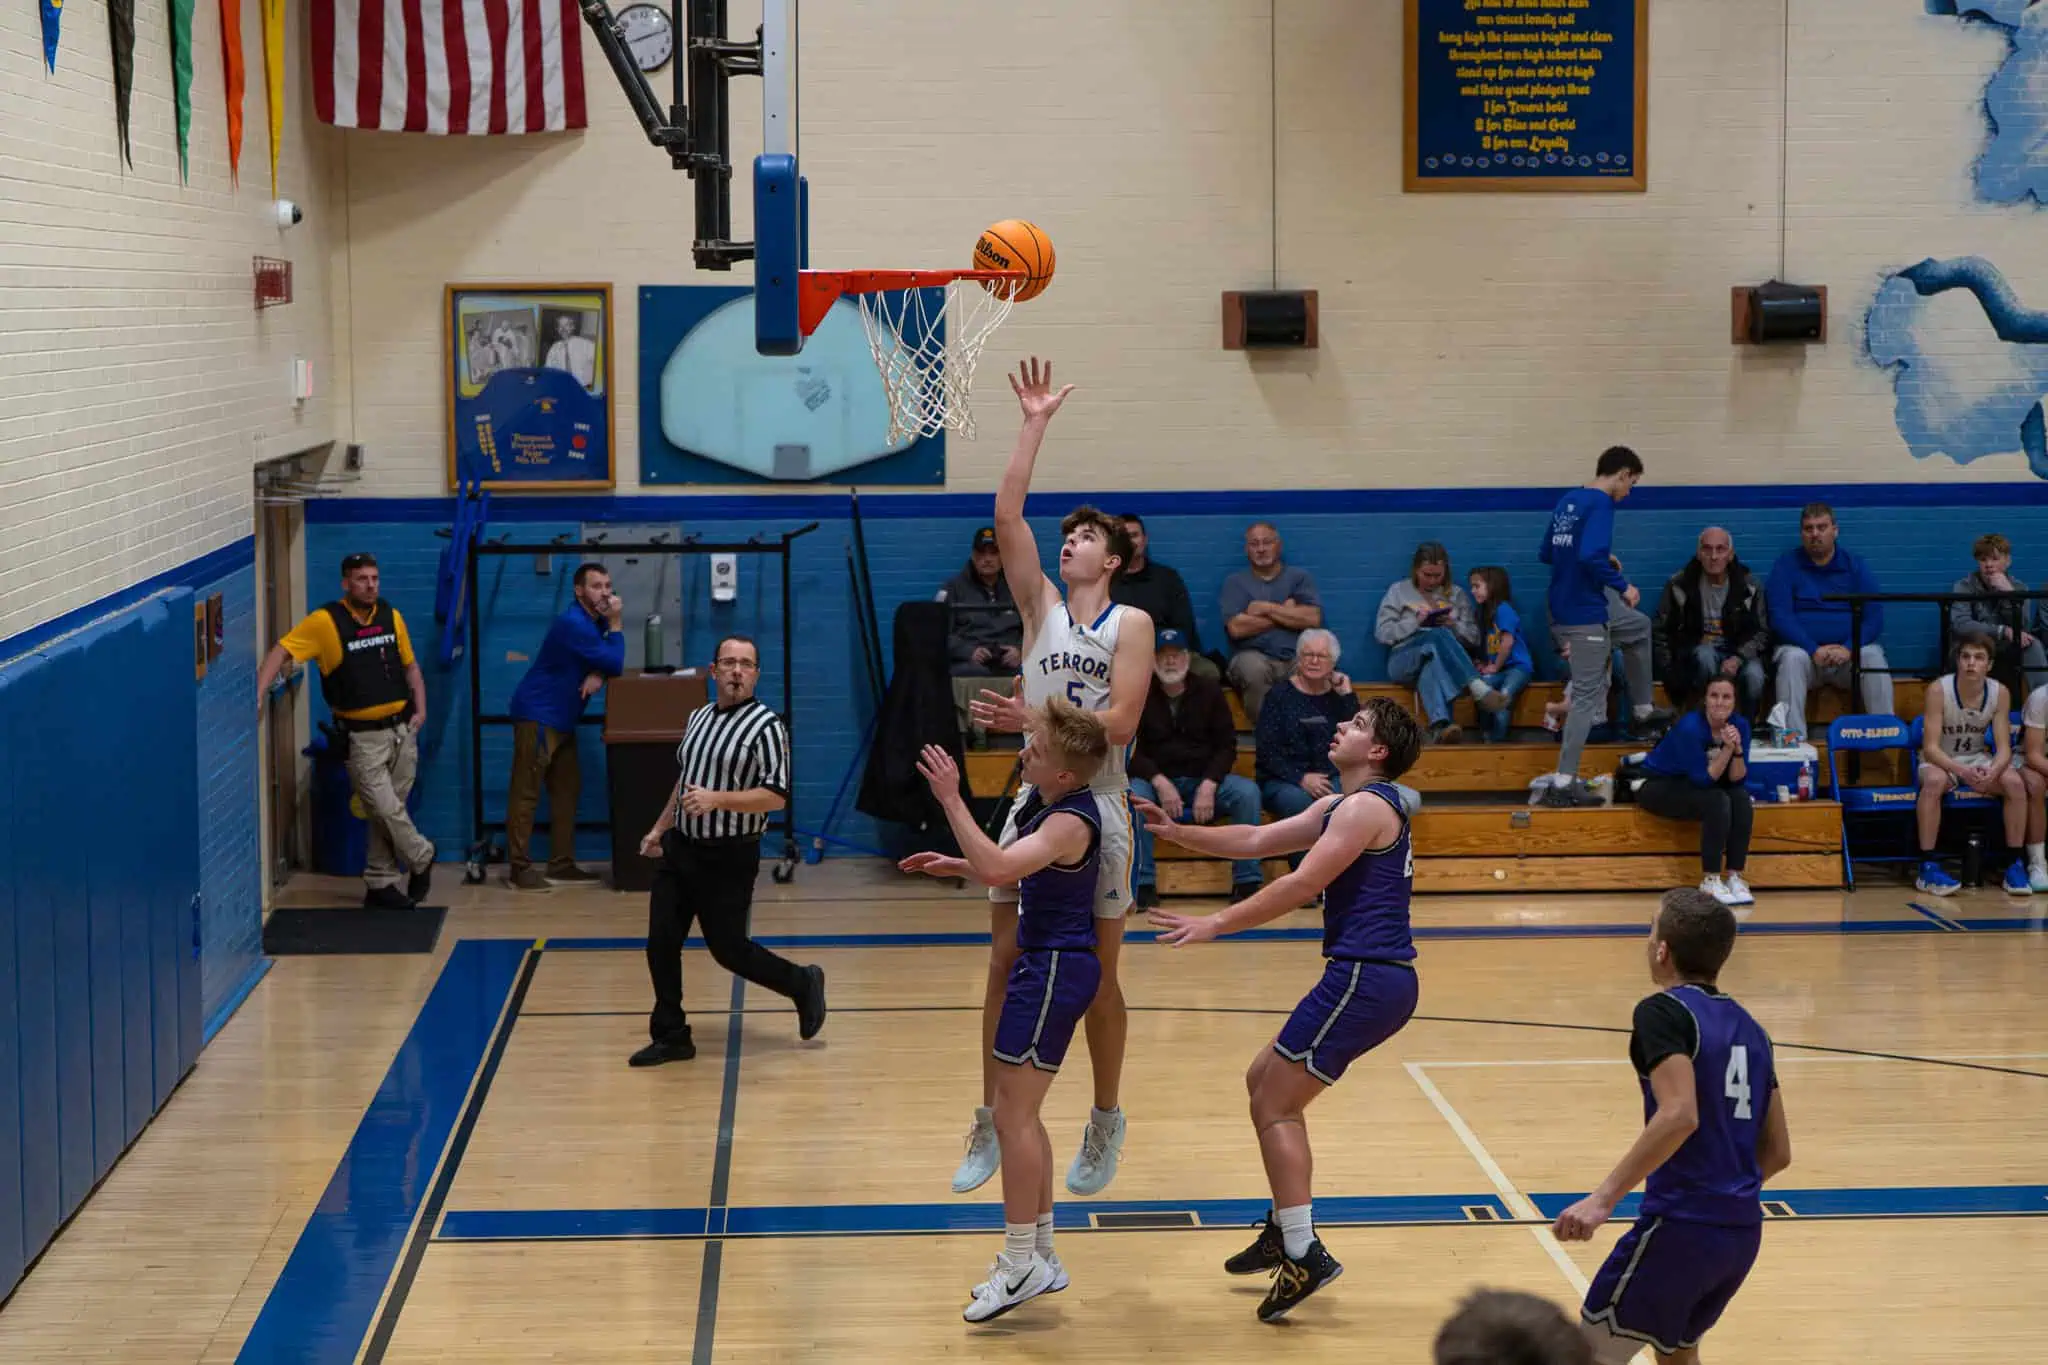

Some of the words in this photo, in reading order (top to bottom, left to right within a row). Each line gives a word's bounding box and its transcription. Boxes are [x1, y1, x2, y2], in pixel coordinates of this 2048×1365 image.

[347, 634, 395, 651] SECURITY
[1039, 651, 1111, 684] TERROR
[1066, 681, 1086, 708] 5
[1953, 737, 1972, 752] 14
[1724, 1045, 1752, 1120] 4
